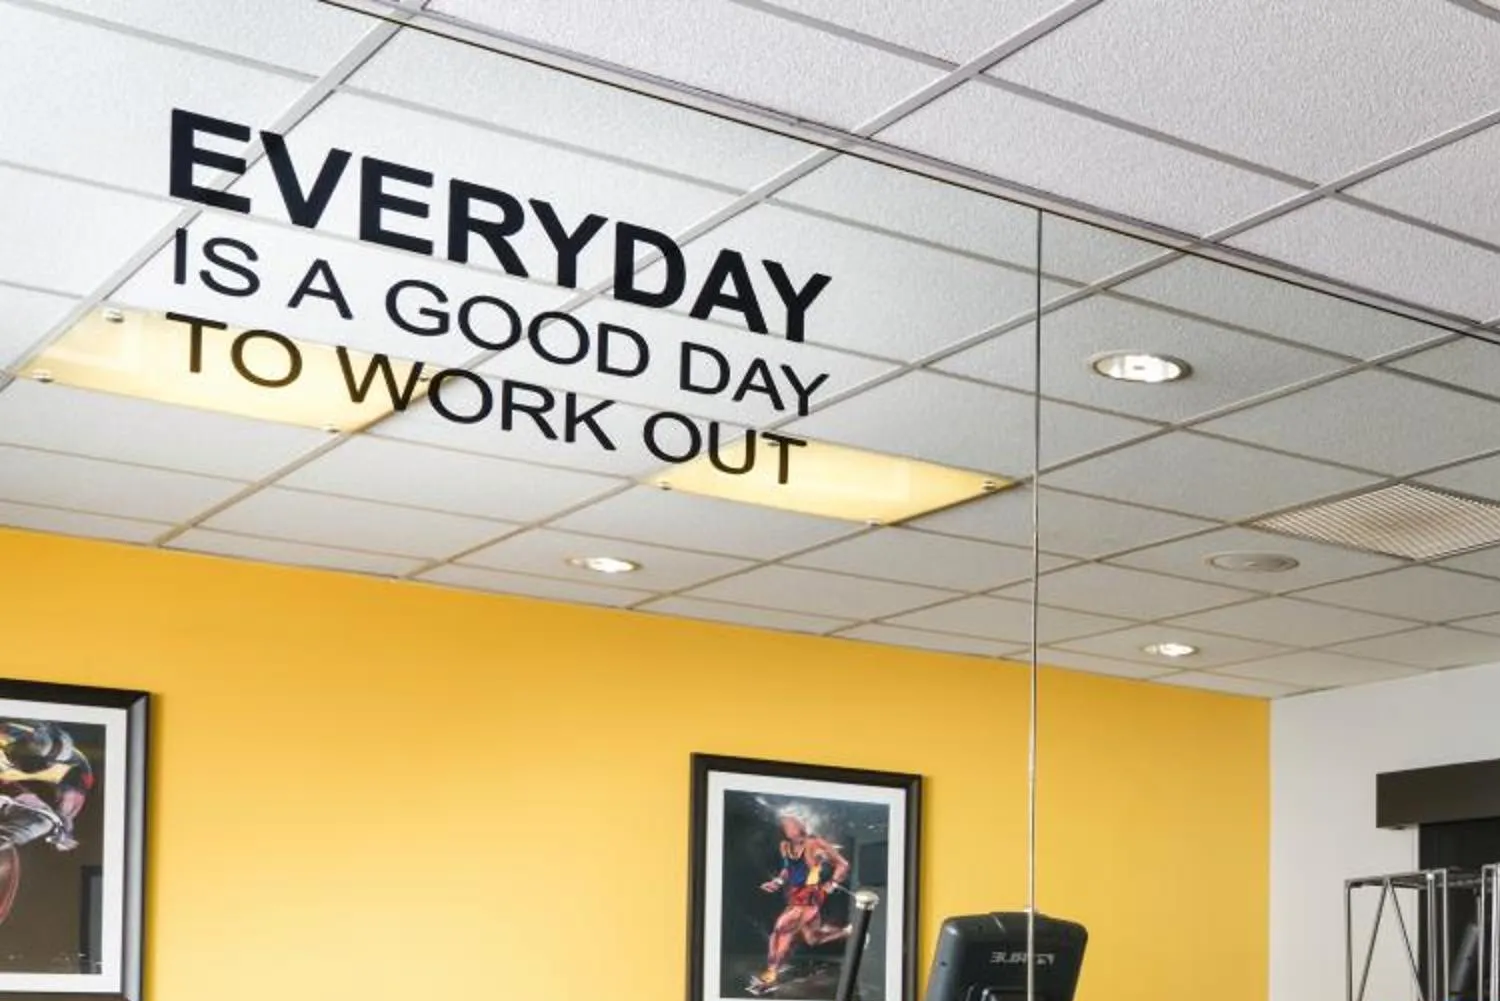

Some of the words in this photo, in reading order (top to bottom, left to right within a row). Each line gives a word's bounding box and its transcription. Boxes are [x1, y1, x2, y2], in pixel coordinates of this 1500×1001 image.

[168, 107, 832, 343] EVERYDAY
[165, 312, 303, 389] TO
[335, 345, 618, 452] WORK
[642, 411, 808, 485] OUT
[173, 227, 261, 298] IS
[287, 259, 353, 321] A
[384, 279, 651, 379] GOOD
[679, 340, 831, 417] DAY
